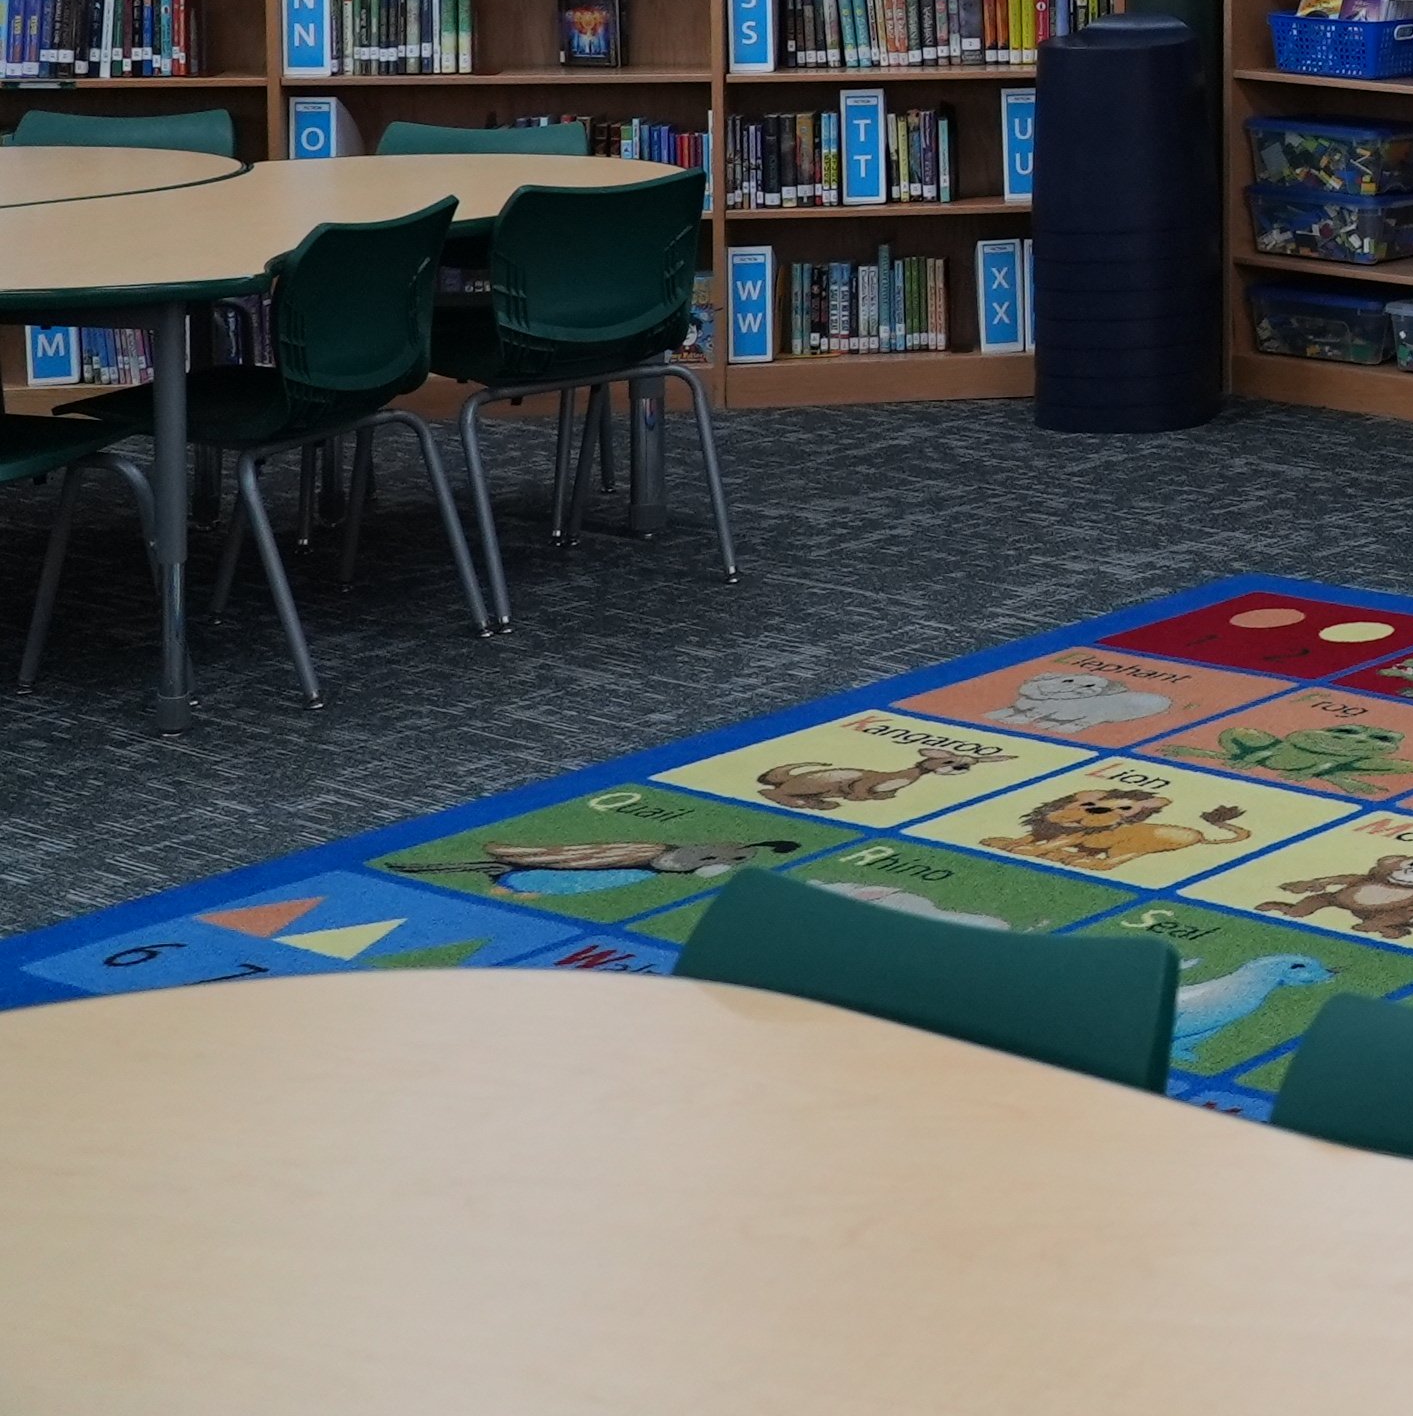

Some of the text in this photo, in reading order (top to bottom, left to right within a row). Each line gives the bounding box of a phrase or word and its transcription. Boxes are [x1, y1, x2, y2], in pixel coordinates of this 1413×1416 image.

[293, 23, 316, 47] N
[742, 21, 758, 45] S
[301, 127, 325, 151] O
[853, 119, 871, 142] T
[1014, 118, 1033, 141] U
[854, 155, 873, 178] T
[1015, 153, 1034, 176] U
[992, 266, 1009, 290] X
[736, 280, 762, 301] W
[738, 312, 763, 334] W
[992, 302, 1010, 325] X
[37, 332, 65, 359] M
[1055, 648, 1191, 687] Elephant
[1288, 686, 1369, 722] Frog
[838, 712, 1006, 759] Kangaroo
[1083, 756, 1173, 794] Lion
[588, 789, 686, 825] Quail
[836, 845, 953, 884] Rhino
[1119, 906, 1225, 945] Seal
[102, 942, 189, 969] 6
